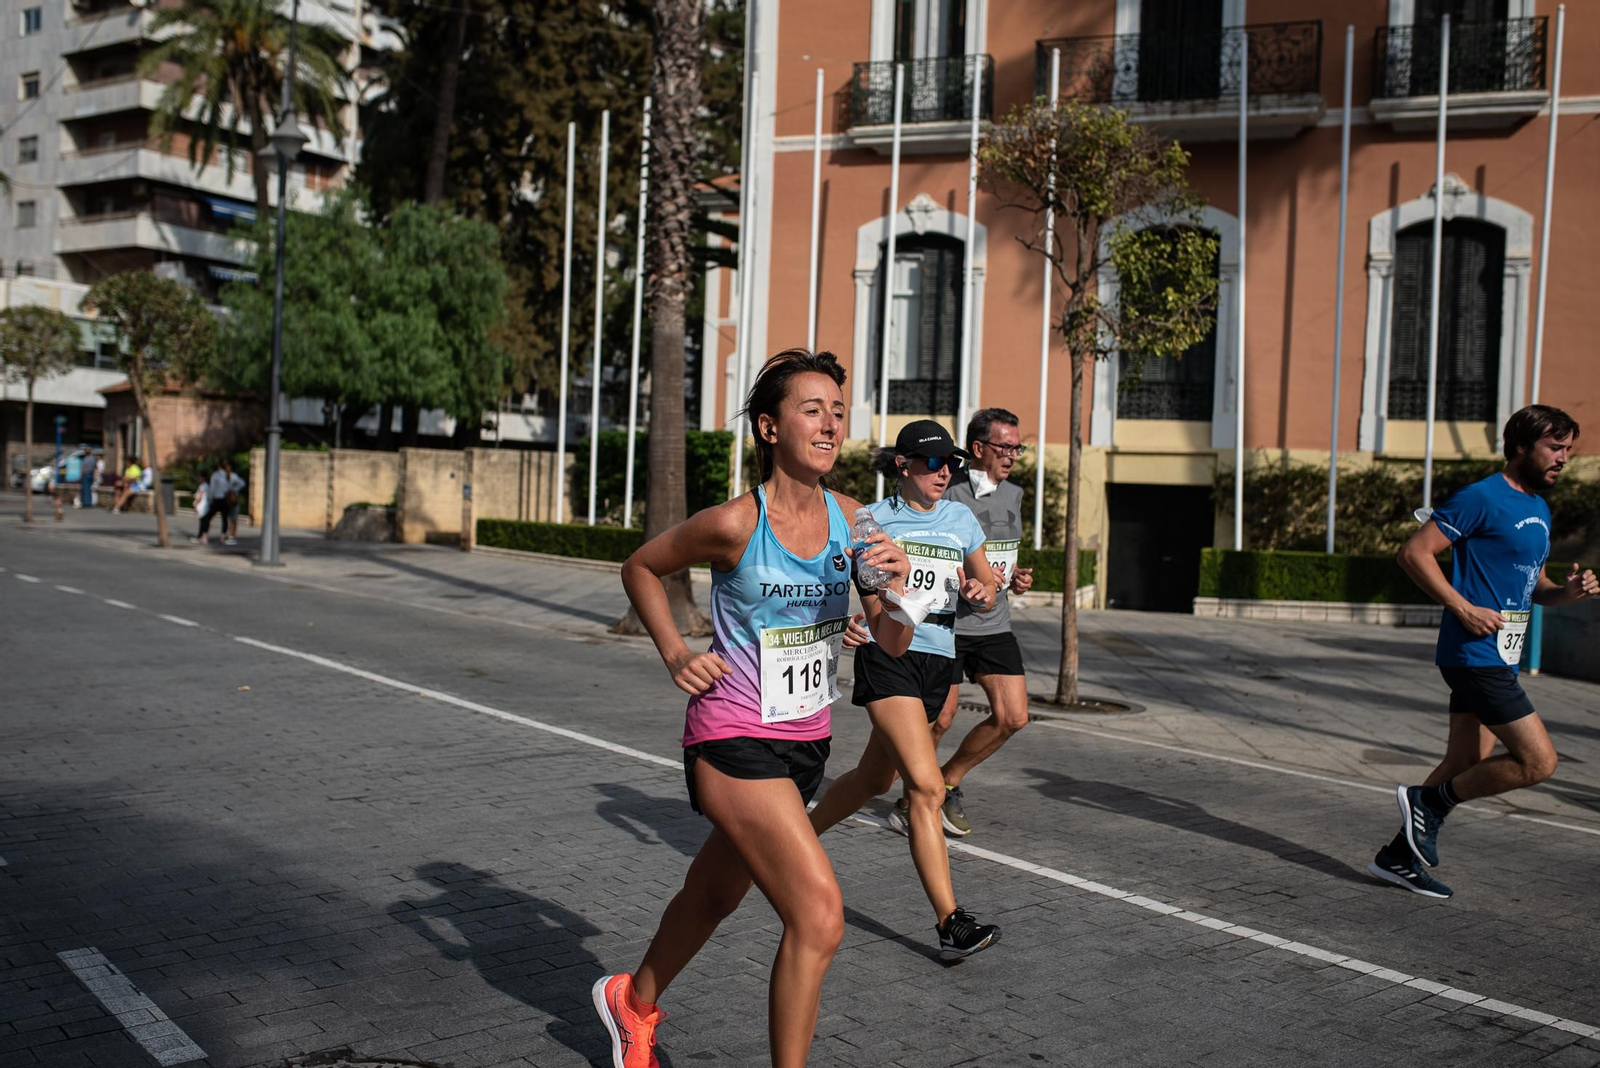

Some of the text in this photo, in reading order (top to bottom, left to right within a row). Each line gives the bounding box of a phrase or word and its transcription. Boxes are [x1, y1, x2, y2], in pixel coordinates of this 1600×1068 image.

[903, 530, 931, 538] VUELTA
[906, 544, 930, 556] VUELTA
[930, 548, 936, 557] A
[936, 548, 959, 560] HUELVA
[759, 581, 850, 597] TARTESSOS
[786, 600, 827, 608] HUELVA
[768, 621, 842, 647] 34 VUELTA A HUELVA
[782, 645, 818, 656] MERCEDES
[782, 659, 822, 695] 118
